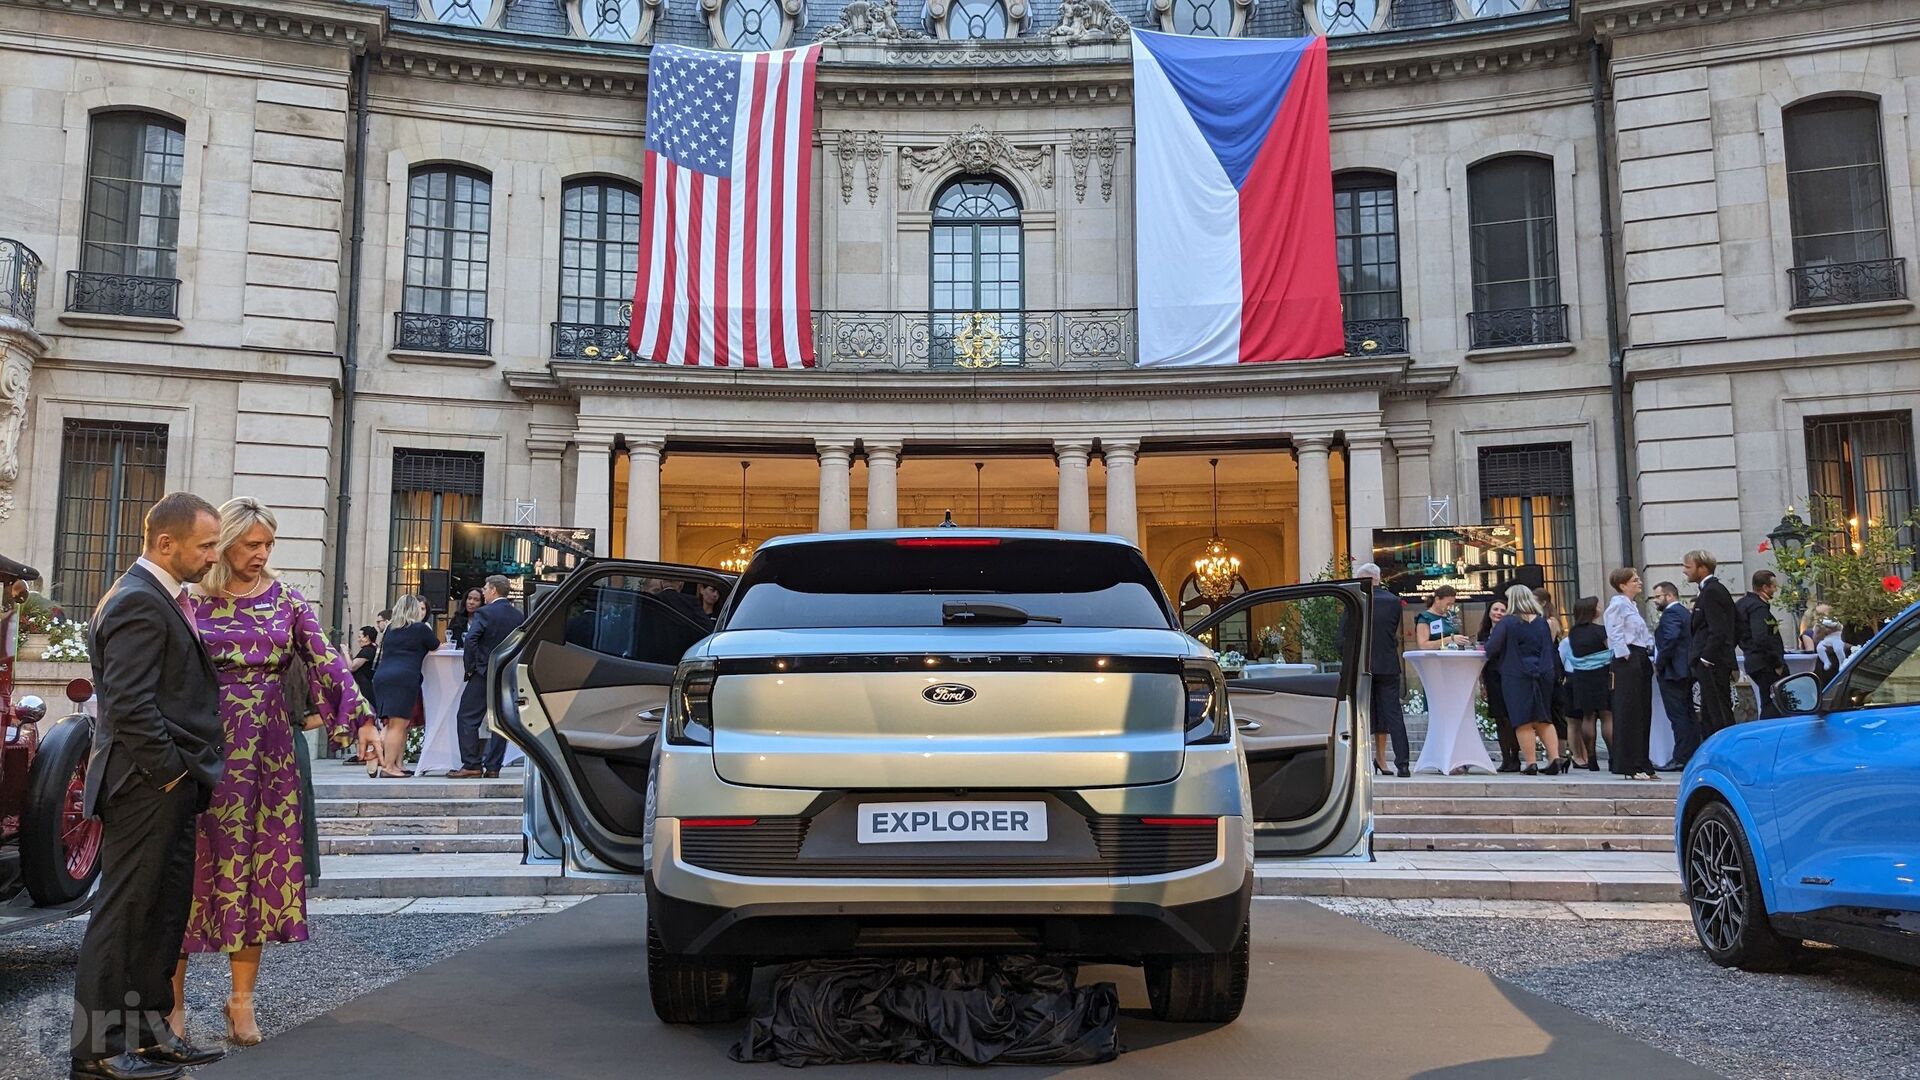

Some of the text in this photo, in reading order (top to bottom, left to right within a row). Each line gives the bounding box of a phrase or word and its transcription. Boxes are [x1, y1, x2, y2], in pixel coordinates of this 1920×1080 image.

[571, 531, 590, 540] Ford
[829, 656, 1063, 665] EXPORER
[872, 810, 1029, 834] EXPLORER
